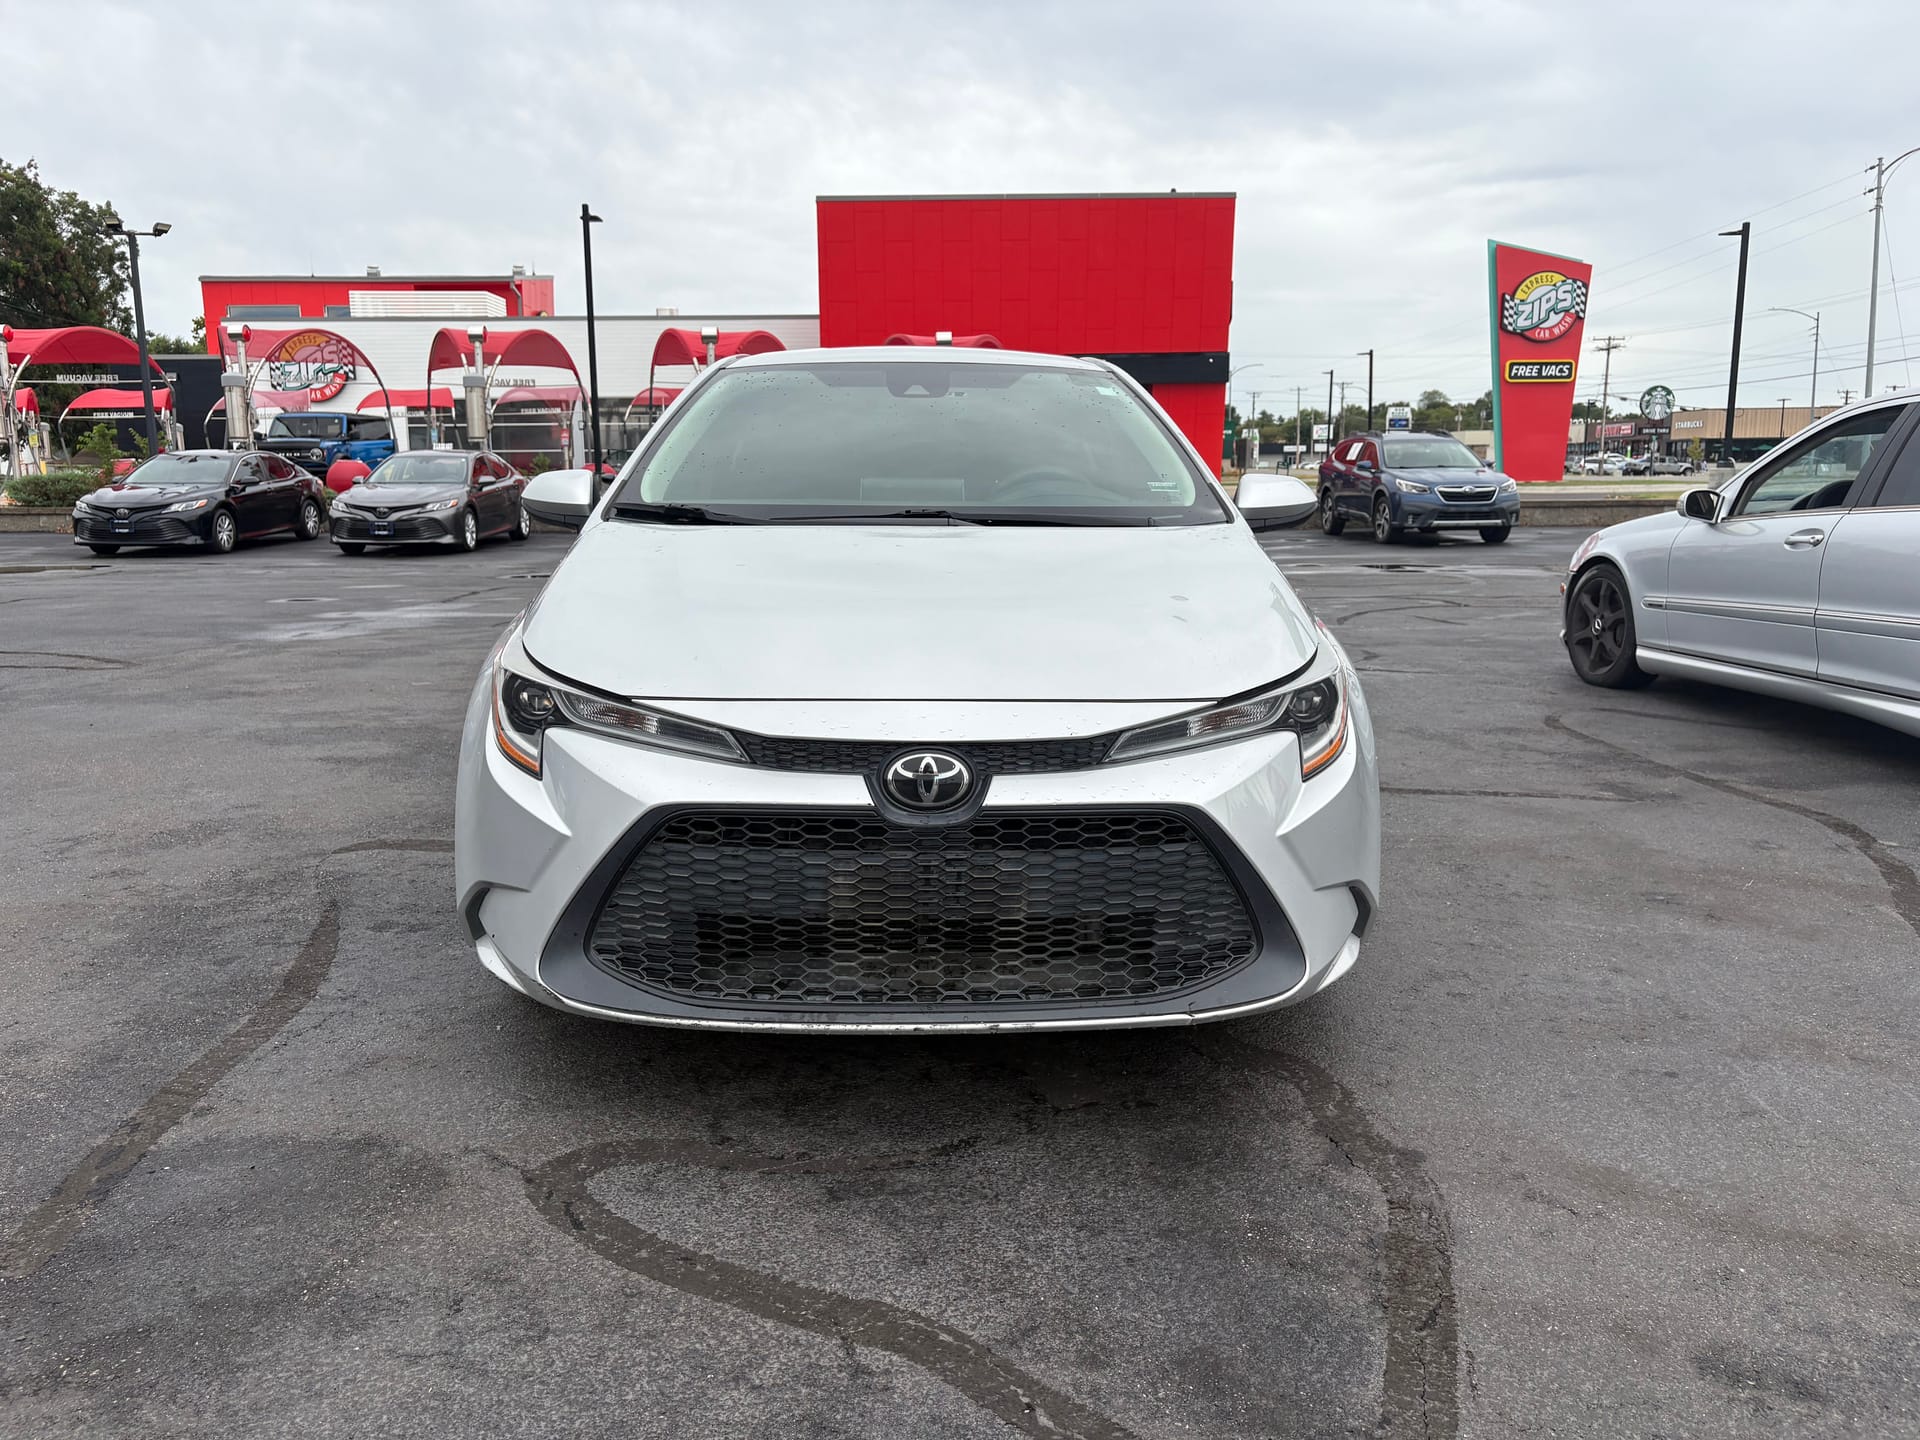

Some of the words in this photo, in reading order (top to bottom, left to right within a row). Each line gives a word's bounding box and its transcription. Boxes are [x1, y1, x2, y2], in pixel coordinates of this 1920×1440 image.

[1521, 275, 1555, 294] EXPRESS
[1516, 283, 1574, 329] ZIPS
[1535, 330, 1550, 338] CAR
[1553, 316, 1573, 336] WASH
[283, 343, 340, 389] ZIPS
[1511, 364, 1540, 377] FREE
[1542, 364, 1570, 376] VACS
[1675, 421, 1703, 430] STARBUCKS
